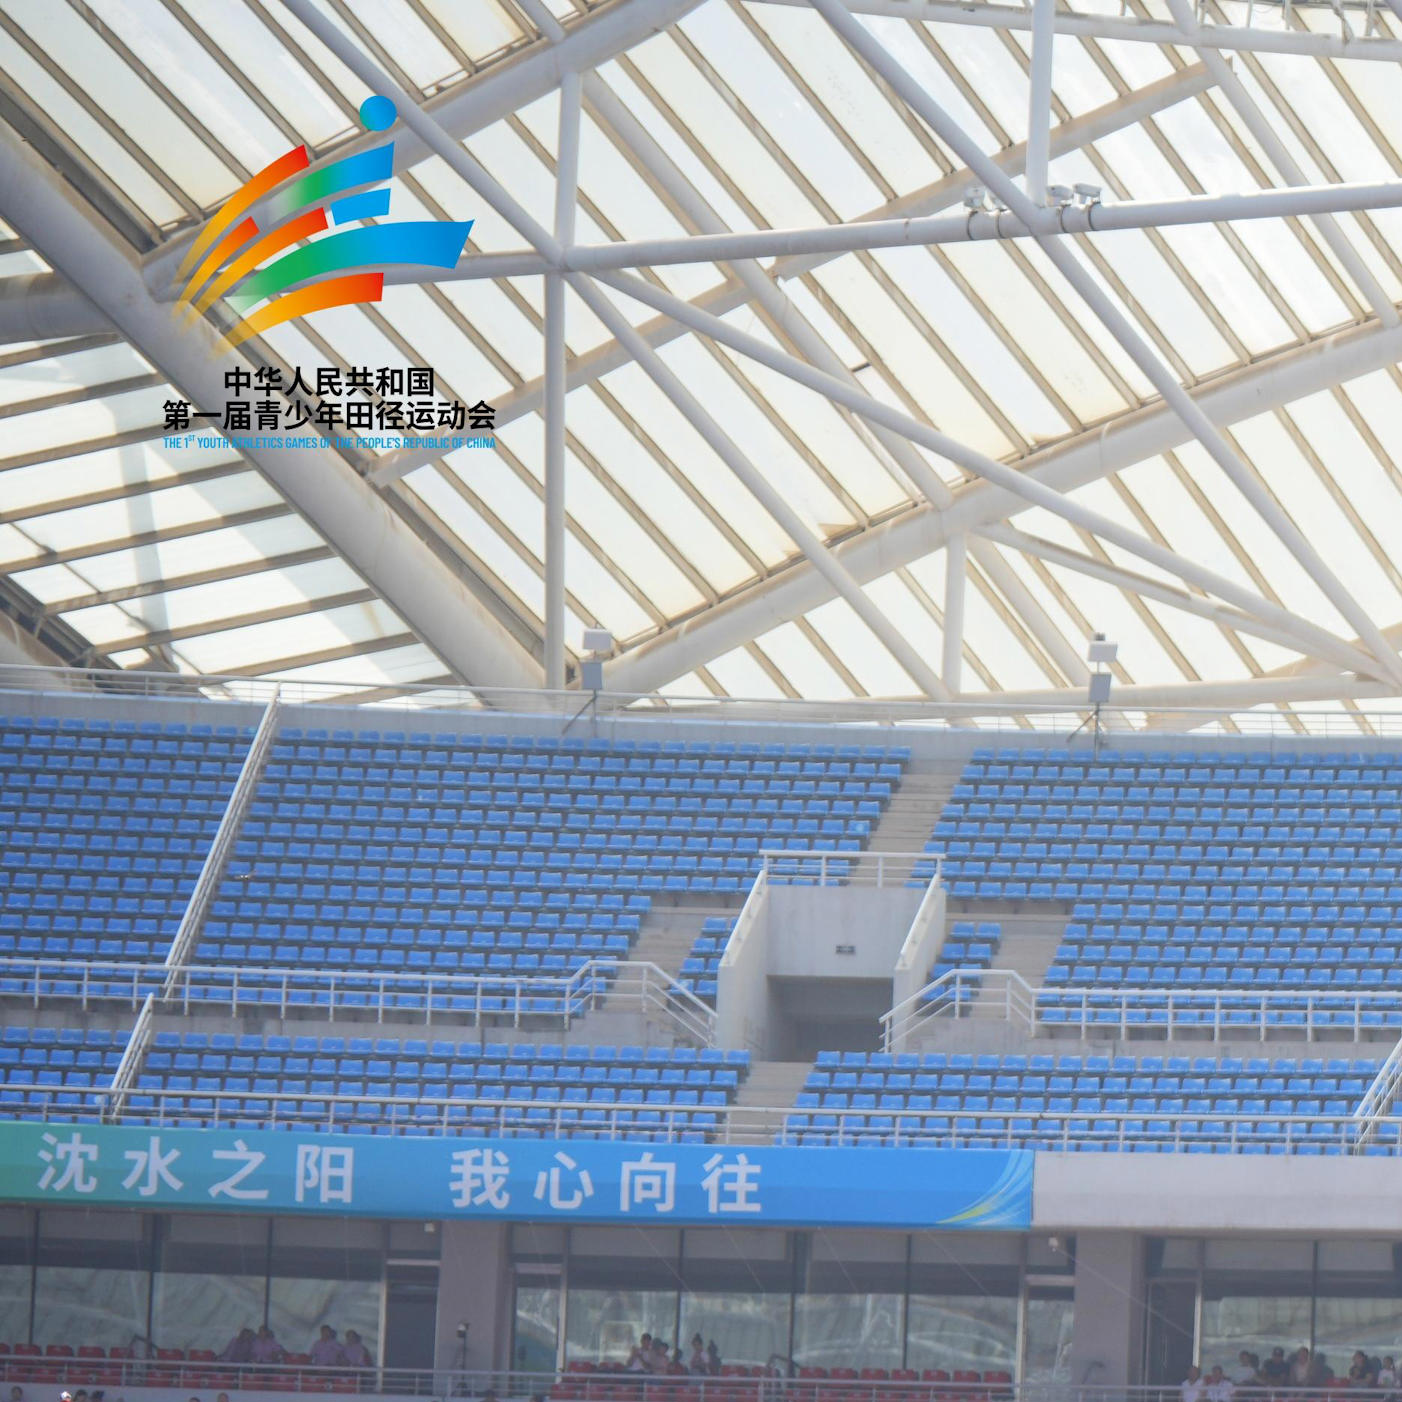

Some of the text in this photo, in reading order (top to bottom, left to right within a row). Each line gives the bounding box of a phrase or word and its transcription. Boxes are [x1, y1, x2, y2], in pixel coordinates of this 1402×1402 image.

[36, 1131, 764, 1215] 沈水之阳 我心向往
